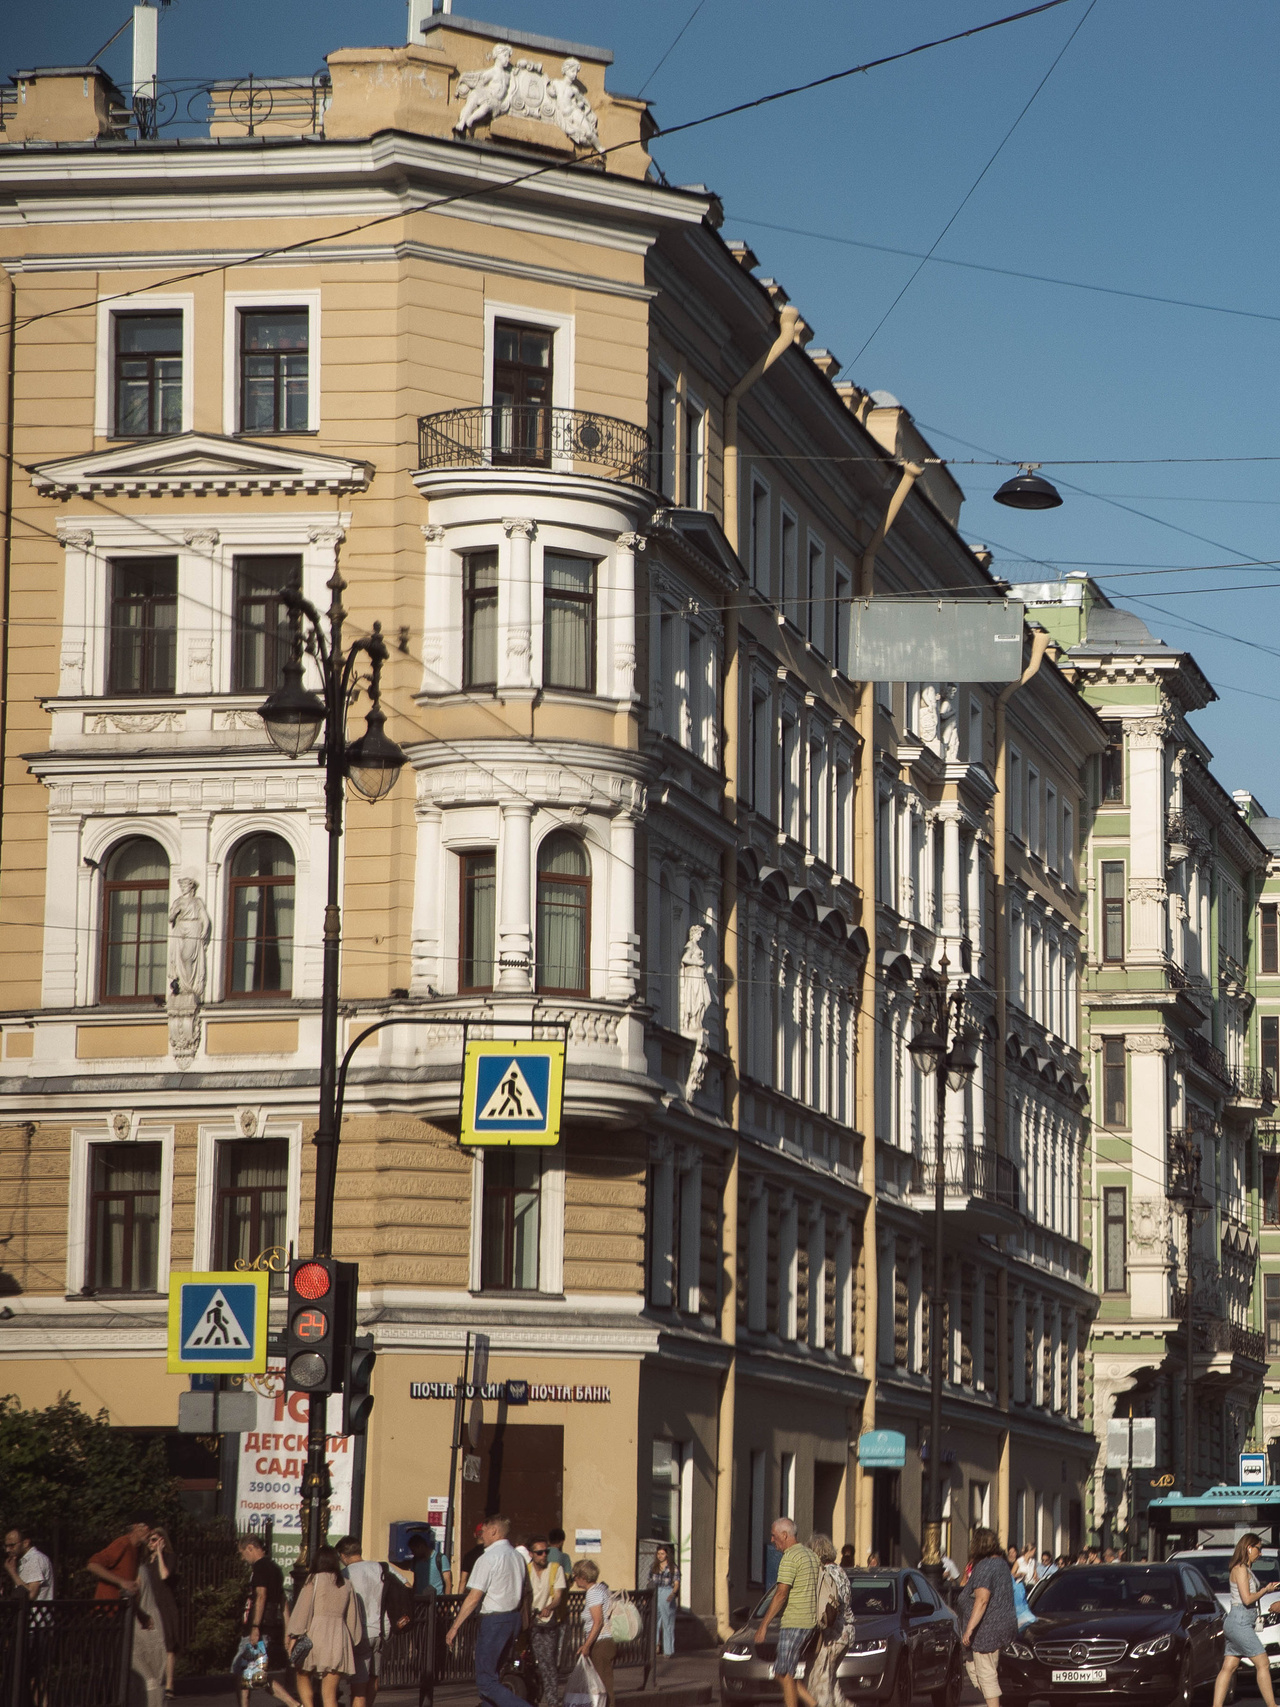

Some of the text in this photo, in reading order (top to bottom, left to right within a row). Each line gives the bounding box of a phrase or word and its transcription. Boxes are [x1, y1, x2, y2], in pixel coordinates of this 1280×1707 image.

[299, 1313, 325, 1336] 24
[412, 1383, 454, 1399] ПОЧТА
[531, 1386, 611, 1401] ПОЧТА БАНК
[244, 1431, 349, 1454] ДЕТСКЙ
[249, 1481, 291, 1493] 39000
[1055, 1670, 1103, 1681] Н980МУ 10
